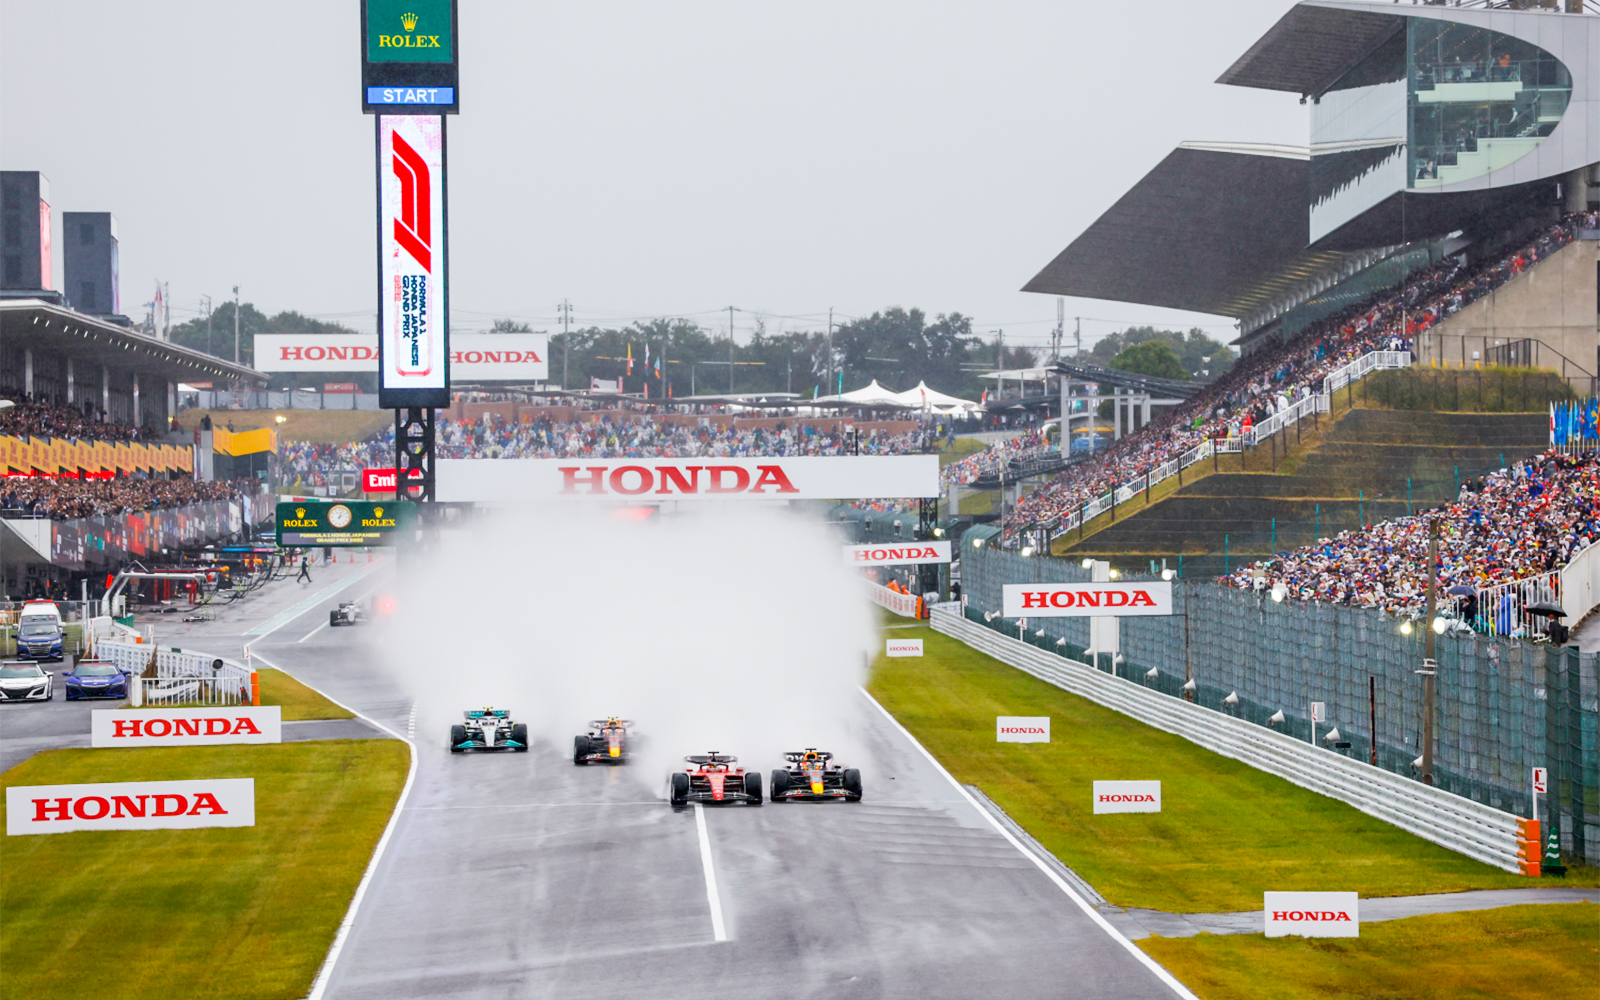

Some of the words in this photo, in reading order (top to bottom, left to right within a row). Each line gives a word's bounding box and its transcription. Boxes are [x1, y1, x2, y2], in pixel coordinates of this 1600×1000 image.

[379, 35, 441, 48] ROLEX
[383, 88, 438, 103] START
[402, 275, 410, 312] GRAND
[411, 313, 419, 366] JAPANESE
[558, 465, 800, 495] HONDA
[361, 519, 396, 527] ROLEX
[853, 547, 940, 561] HONDA
[1021, 590, 1157, 608] HONDA
[112, 717, 262, 737] HONDA
[1099, 794, 1155, 802] HONDA
[31, 792, 228, 821] HONDA
[1272, 911, 1352, 921] HONDA
